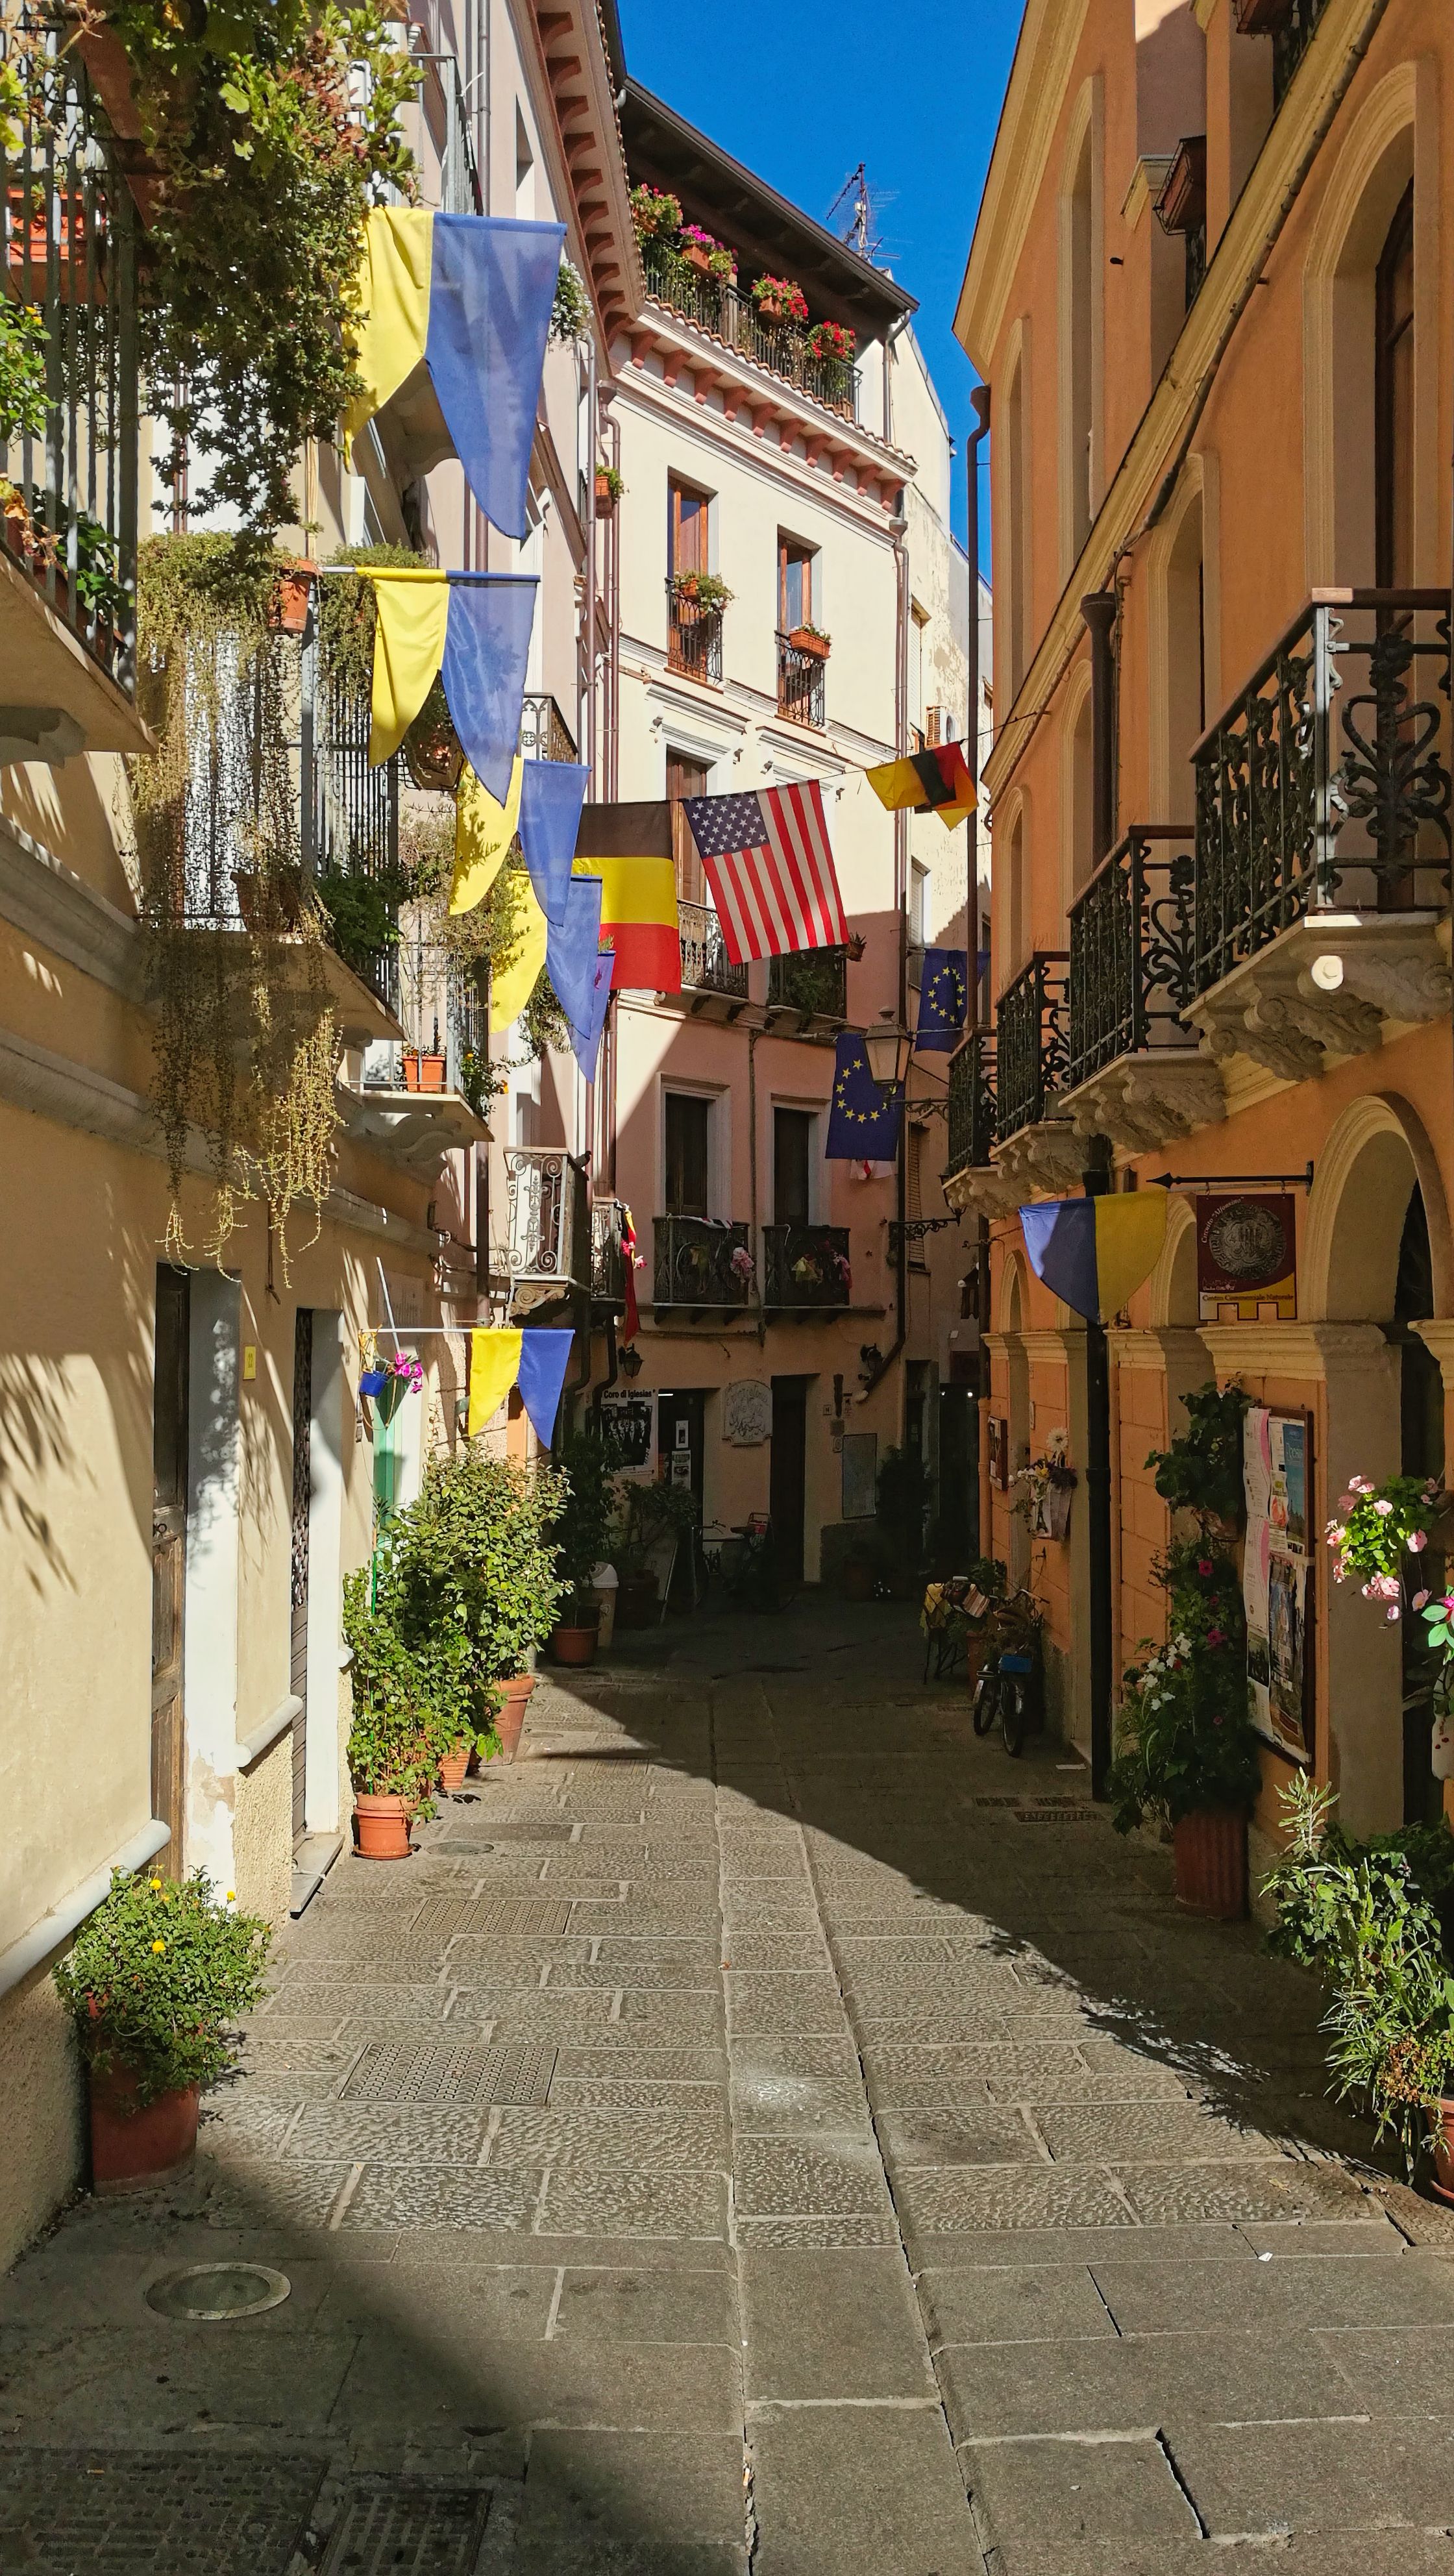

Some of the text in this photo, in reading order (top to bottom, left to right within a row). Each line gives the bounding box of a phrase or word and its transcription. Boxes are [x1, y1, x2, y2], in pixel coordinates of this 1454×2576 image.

[1201, 1218, 1214, 1243] Circuito
[604, 1390, 619, 1398] Coro
[620, 1389, 626, 1398] di
